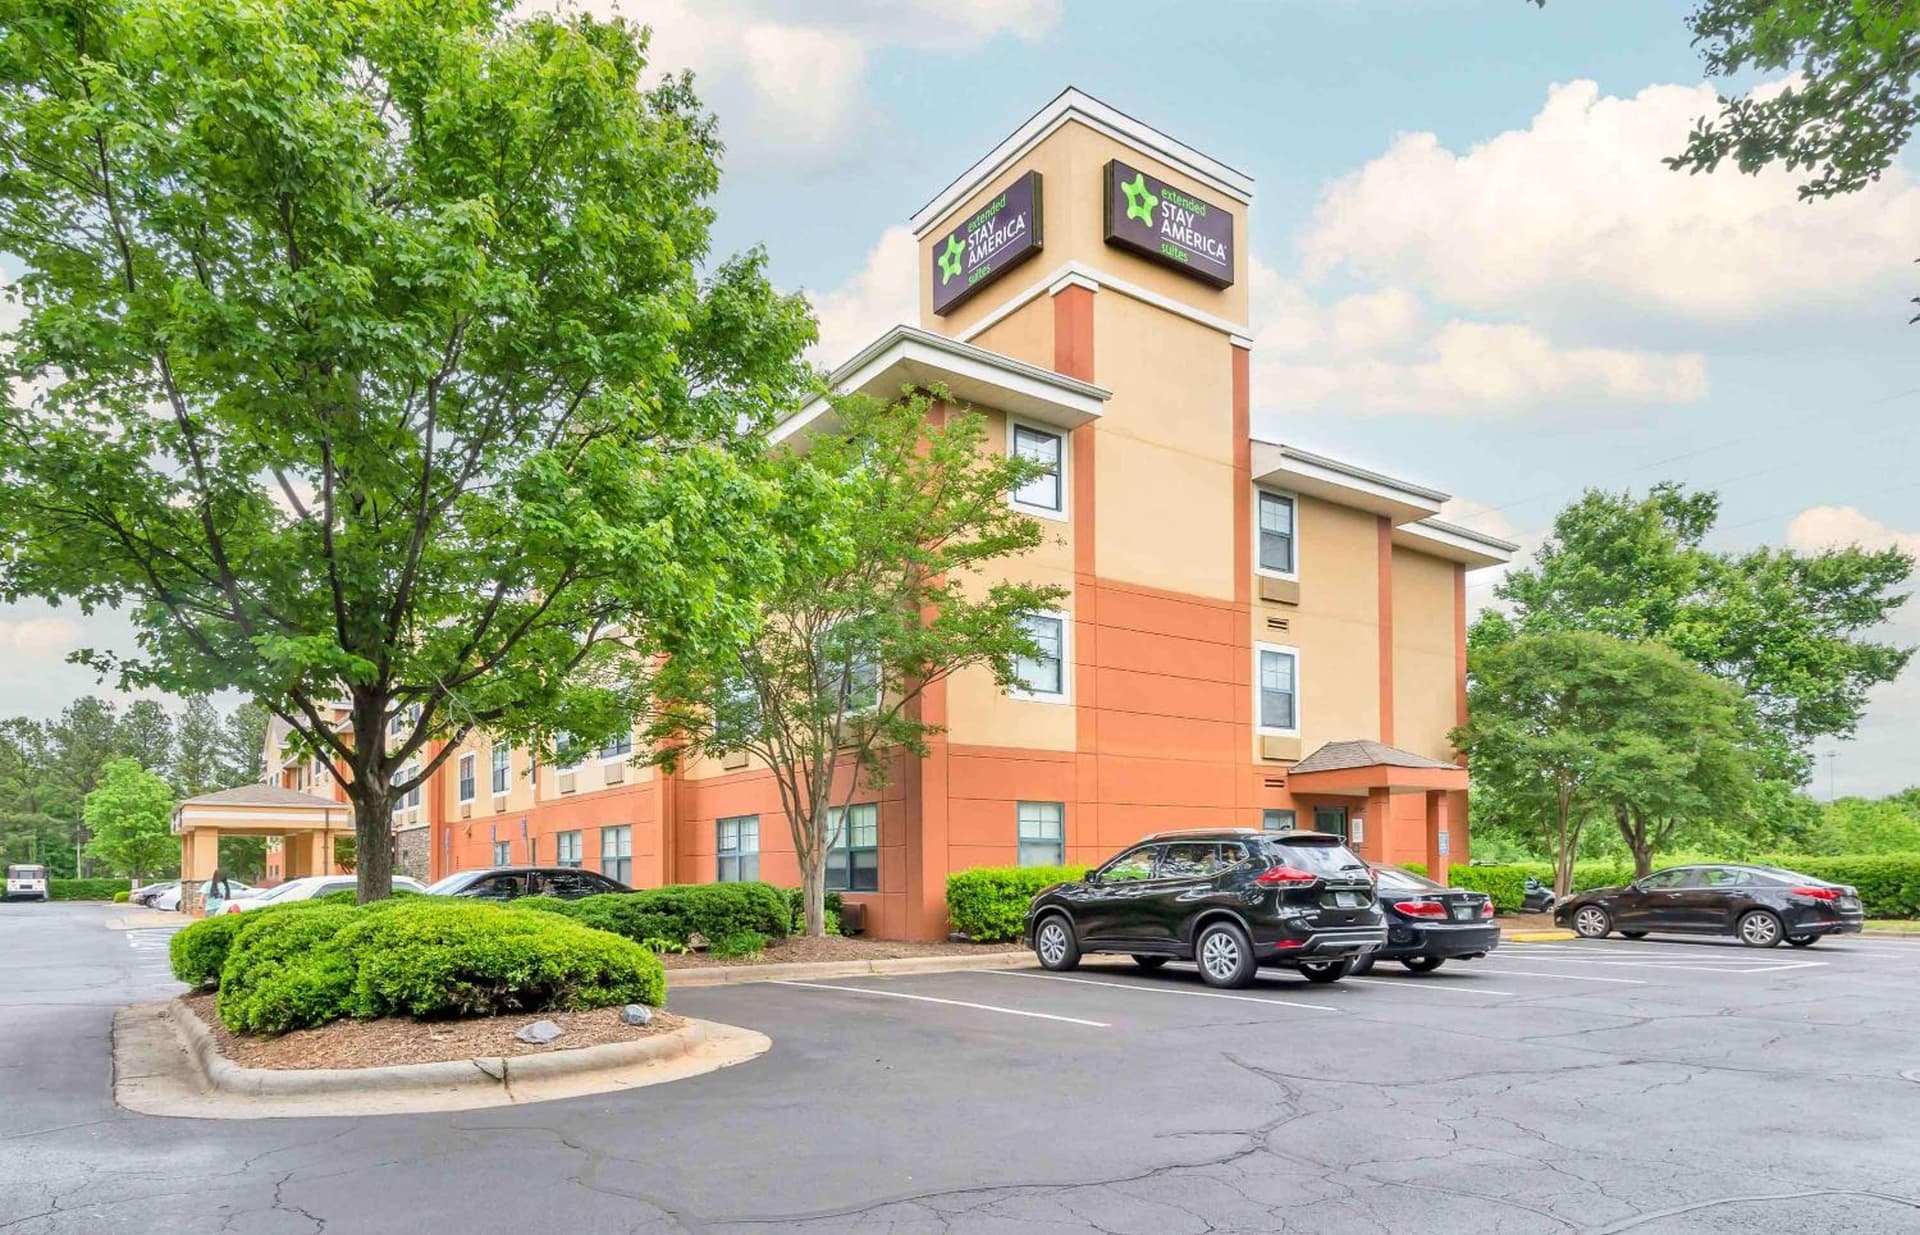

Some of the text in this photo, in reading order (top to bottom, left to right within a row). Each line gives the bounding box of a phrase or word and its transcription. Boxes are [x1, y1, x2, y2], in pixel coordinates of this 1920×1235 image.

[968, 194, 1006, 232] extended
[1161, 188, 1206, 216] extended
[1161, 201, 1194, 228] STAY
[968, 217, 995, 250] STAY
[968, 214, 1025, 268] AMERICA
[1161, 219, 1226, 260] AMERICA
[1161, 243, 1188, 263] suites
[968, 264, 991, 286] suites
